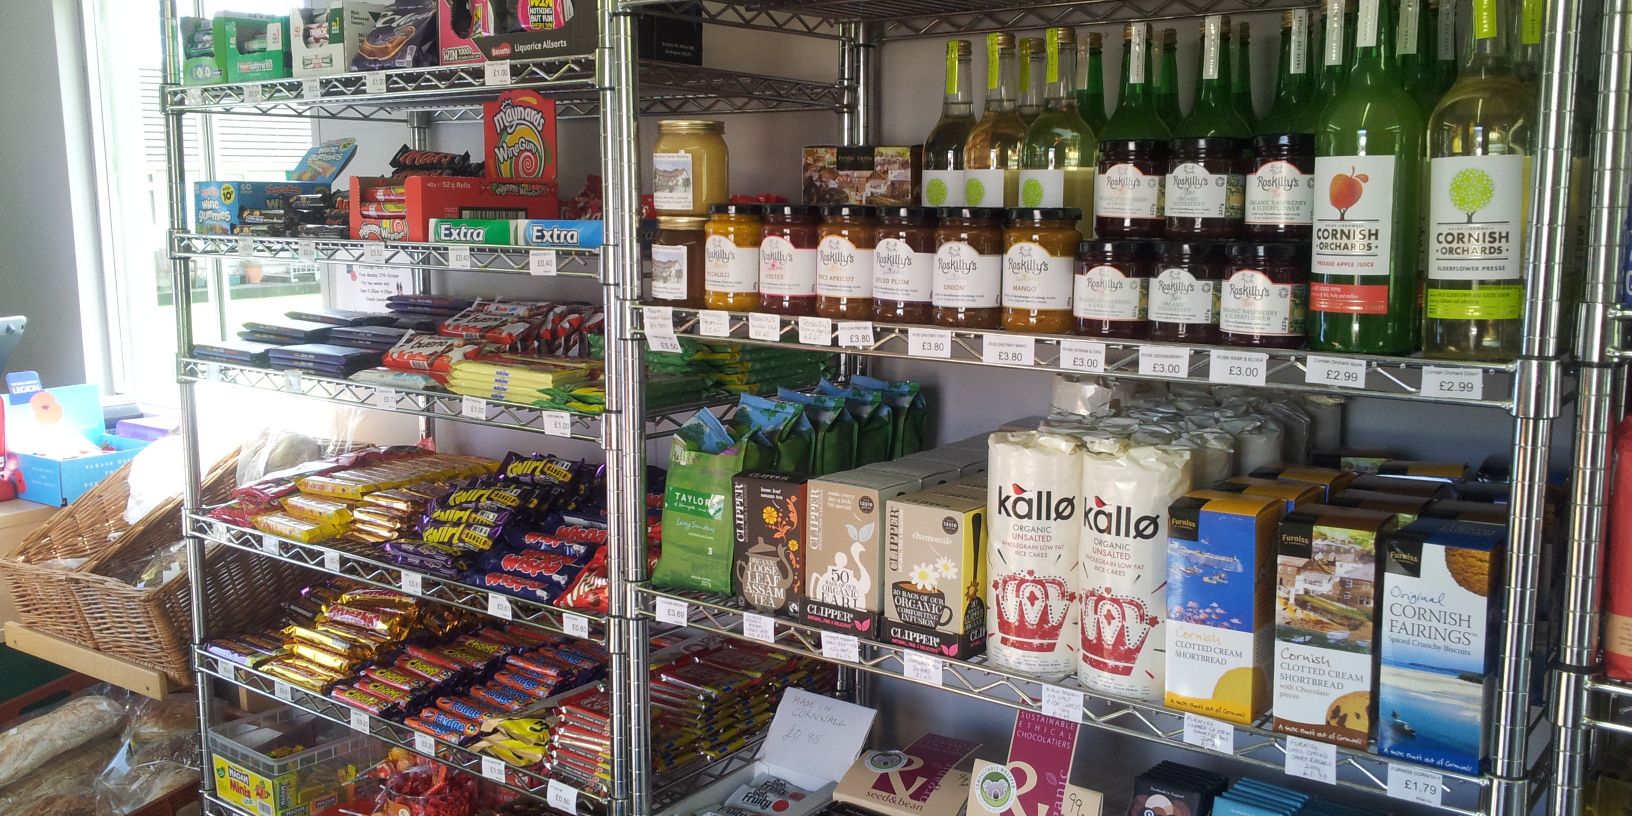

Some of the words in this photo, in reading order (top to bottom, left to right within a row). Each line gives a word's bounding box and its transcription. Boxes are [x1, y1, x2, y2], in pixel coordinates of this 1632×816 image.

[530, 14, 541, 22] BUT
[514, 42, 542, 54] Liquorice
[542, 39, 568, 48] Allsorts
[493, 68, 508, 76] £1.00
[1106, 176, 1141, 190] Roskilly's
[1172, 176, 1209, 190] Roskilly's
[1256, 176, 1299, 192] Roskilly's
[201, 199, 220, 210] wine
[198, 210, 232, 224] gummies
[440, 224, 485, 242] Extra
[532, 224, 578, 244] Extra
[1316, 228, 1379, 241] CORNISH
[1436, 231, 1510, 244] CORNISH
[1319, 242, 1373, 252] ORCHARDS
[1440, 245, 1503, 256] ORCHARDS
[820, 250, 854, 266] Roskilly's
[876, 252, 912, 270] Roskilly's
[938, 258, 977, 274] Roskilly's
[1008, 258, 1049, 274] Roskilly's
[1012, 284, 1037, 292] MANGO
[1087, 278, 1124, 292] Roskilly's
[1158, 280, 1195, 296] Roskilly's
[1229, 284, 1270, 300] Roskilly's
[411, 340, 448, 348] bueno
[850, 334, 870, 343] £3.80
[922, 342, 944, 352] £3.80
[998, 352, 1022, 362] £3.80
[1072, 358, 1098, 368] £3.00
[1152, 363, 1180, 374] £3.00
[1228, 366, 1259, 378] £3.00
[1326, 369, 1358, 382] £2.99
[1439, 380, 1474, 393] £2.99
[674, 492, 719, 509] TAYLORS
[736, 484, 744, 542] CLIPPER
[810, 488, 820, 550] CLIPPER
[1012, 524, 1052, 534] ORGANIC
[1171, 517, 1196, 528] Furniss
[890, 508, 900, 572] CLIPPER
[912, 532, 952, 545] chamomile
[1012, 532, 1052, 543] UNSALTED
[1282, 534, 1309, 545] Furniss
[708, 547, 712, 555] 3
[1001, 540, 1038, 550] WHOLEGRAIN
[1093, 538, 1130, 552] ORGANIC
[1092, 546, 1131, 560] UNSALTED
[1390, 550, 1418, 562] Furniss
[749, 562, 779, 575] LOOSE
[1106, 568, 1126, 577] CAKES
[1120, 562, 1132, 570] LOW
[747, 572, 781, 586] LEAF
[832, 569, 850, 583] 50
[744, 583, 785, 600] ASSAM
[822, 584, 860, 598] ORGANIC
[901, 590, 919, 600] BAGS
[920, 592, 928, 600] OF
[929, 594, 944, 605] OUR
[1390, 586, 1446, 606] Original
[752, 594, 776, 608] TEA
[894, 596, 943, 614] ORGANIC
[807, 604, 852, 622] CLIPPER
[898, 607, 938, 620] COMFORTING
[1390, 602, 1472, 628] CORNISH
[901, 614, 936, 628] INFUSION
[891, 628, 938, 648] CLIPPER
[1175, 626, 1222, 646] Cornish
[1389, 620, 1472, 646] FAIRINGS
[1175, 640, 1211, 655] CLOTTED
[1212, 646, 1243, 658] CREAM
[1389, 636, 1410, 648] Spiced
[1412, 638, 1442, 652] Crunchy
[1443, 644, 1471, 656] Biscuits
[1174, 650, 1228, 666] SHORTBREAD
[1280, 648, 1332, 668] Cornish
[408, 658, 438, 674] Chomp
[1280, 662, 1325, 677] CLOTTED
[1328, 670, 1364, 683] CREAM
[508, 674, 538, 690] Fudge
[1280, 672, 1344, 690] SHORTBREAD
[1280, 682, 1294, 690] with
[1295, 685, 1330, 698] Chocolate
[451, 702, 482, 719] Fudge
[1215, 705, 1223, 714] of
[434, 713, 466, 732] Fudge
[1020, 711, 1075, 730] SUSTAINABLE
[1018, 720, 1072, 740] ETHICAL
[1330, 732, 1336, 740] of
[1016, 730, 1072, 750] CHOCOLATIERS
[1424, 756, 1434, 764] out
[1436, 758, 1444, 767] of
[753, 790, 768, 798] Get
[1404, 778, 1437, 796] £1.79
[742, 792, 772, 811] Fruity
[866, 791, 924, 812] seed&bean
